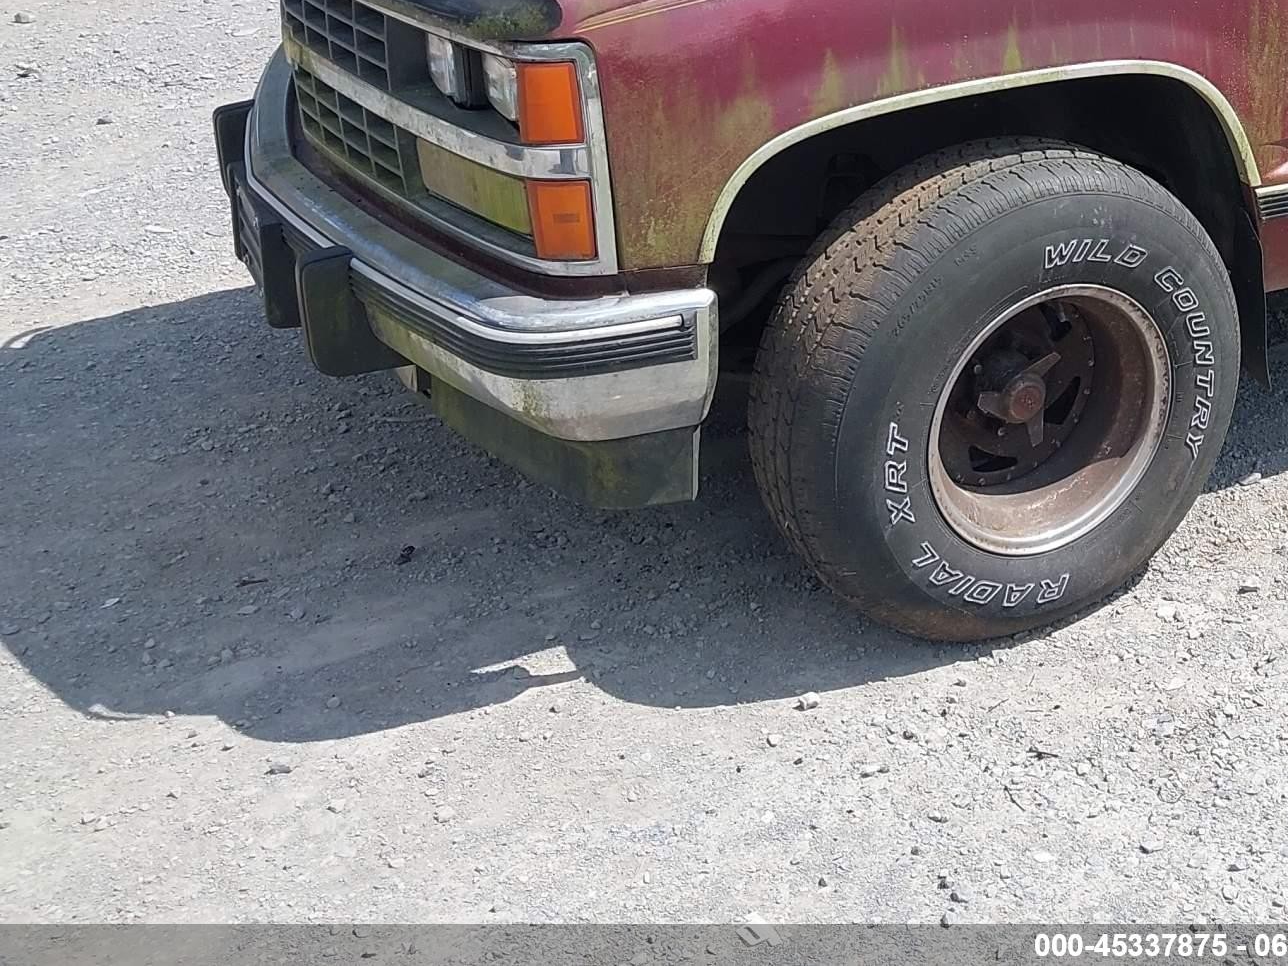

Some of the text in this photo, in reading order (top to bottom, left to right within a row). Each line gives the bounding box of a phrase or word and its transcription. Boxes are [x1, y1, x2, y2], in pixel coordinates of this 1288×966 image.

[1045, 238, 1216, 459] WILD COUNTRY
[885, 421, 1070, 608] RADIAL XRT
